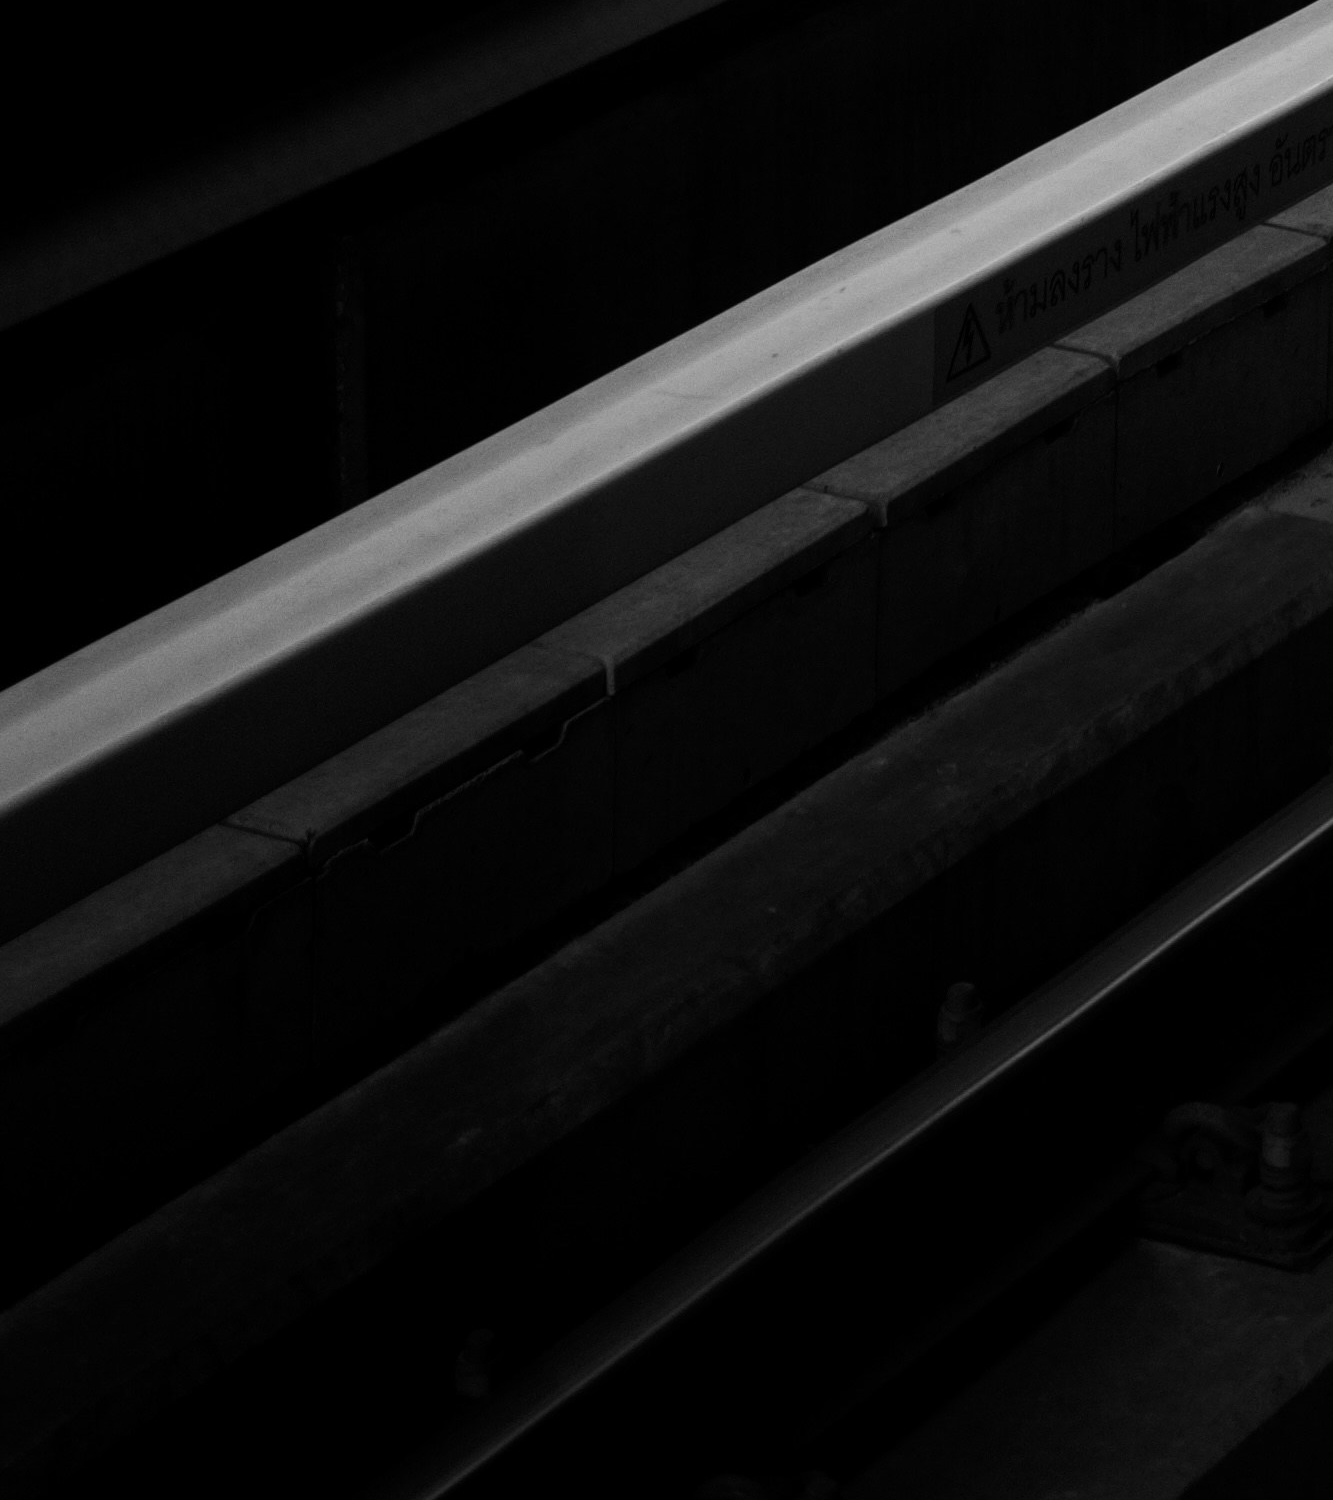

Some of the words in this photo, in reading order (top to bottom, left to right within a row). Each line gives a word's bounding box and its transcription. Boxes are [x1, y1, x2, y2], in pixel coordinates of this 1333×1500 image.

[995, 238, 1122, 334] ห้ามลงราง
[1130, 162, 1261, 262] ไฟฟ้าแรงสูง
